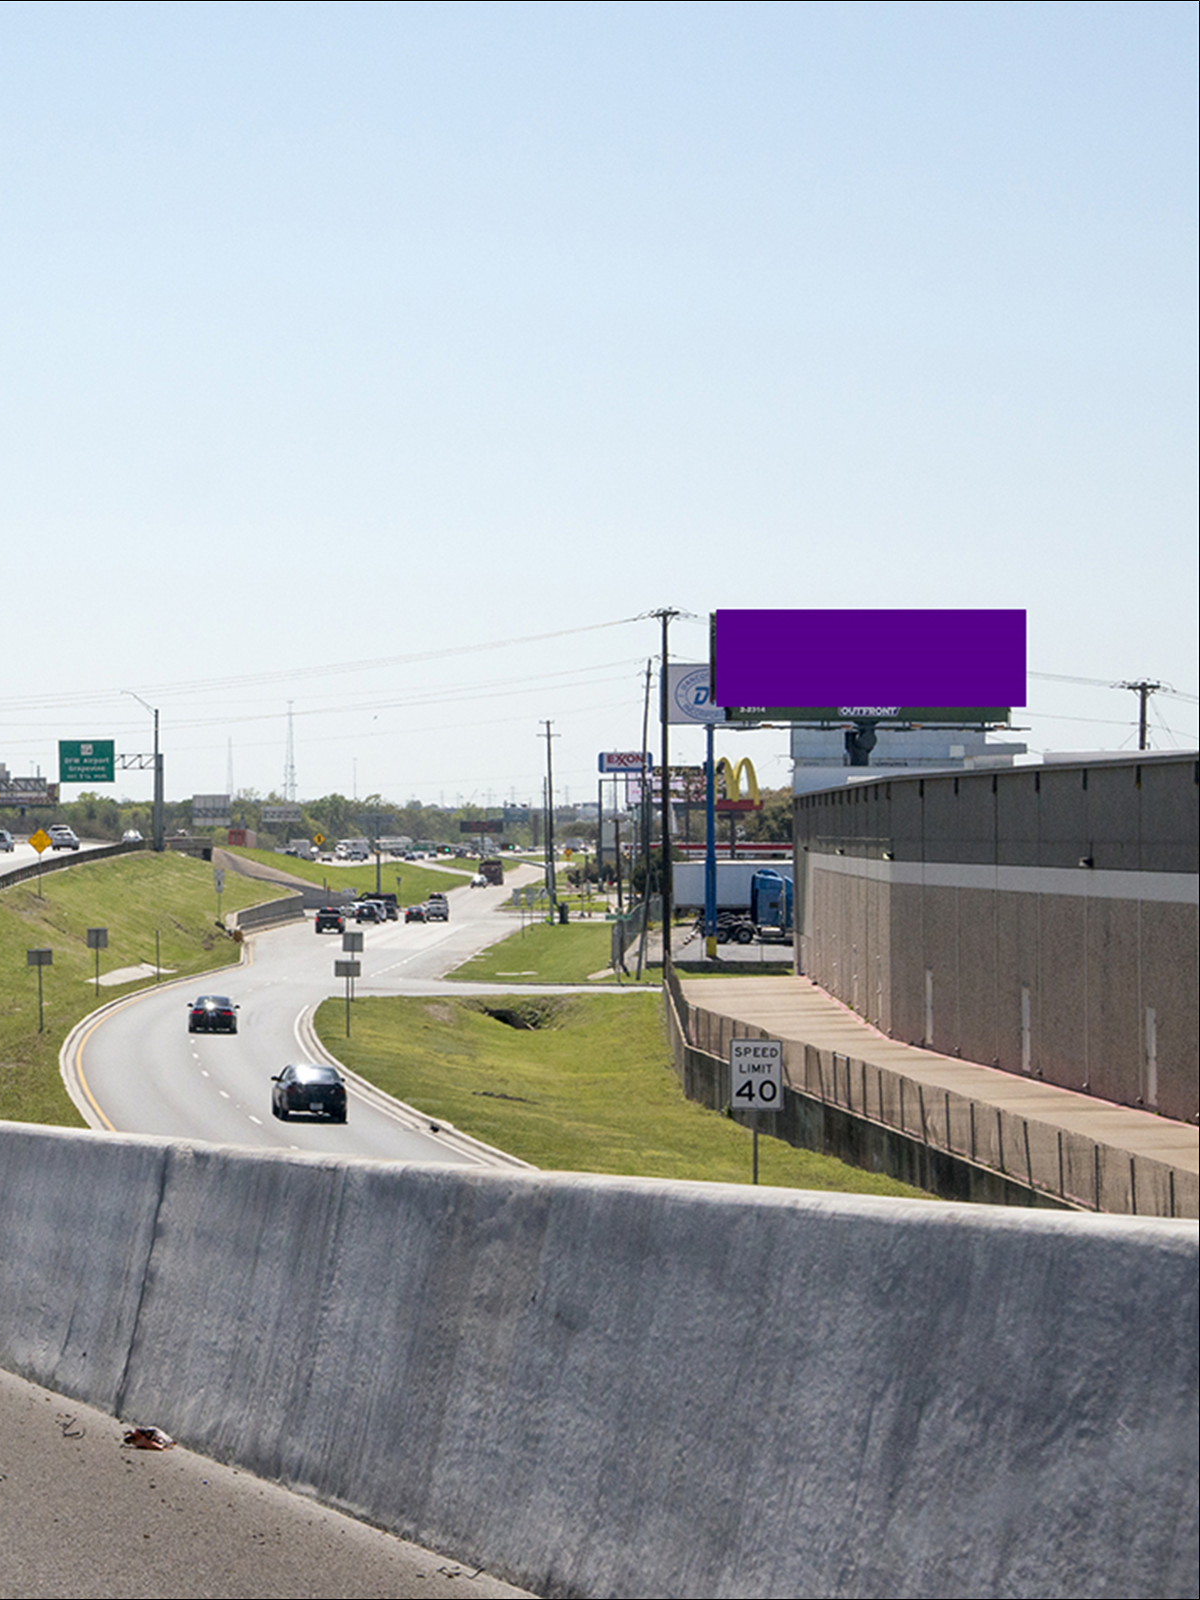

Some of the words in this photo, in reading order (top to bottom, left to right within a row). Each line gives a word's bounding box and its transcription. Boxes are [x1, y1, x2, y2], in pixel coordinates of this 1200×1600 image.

[840, 707, 898, 716] OUTFRONT
[607, 753, 644, 767] EXXON
[734, 1047, 779, 1058] SPEED
[739, 1063, 773, 1074] LIMIT
[735, 1080, 777, 1102] 40
